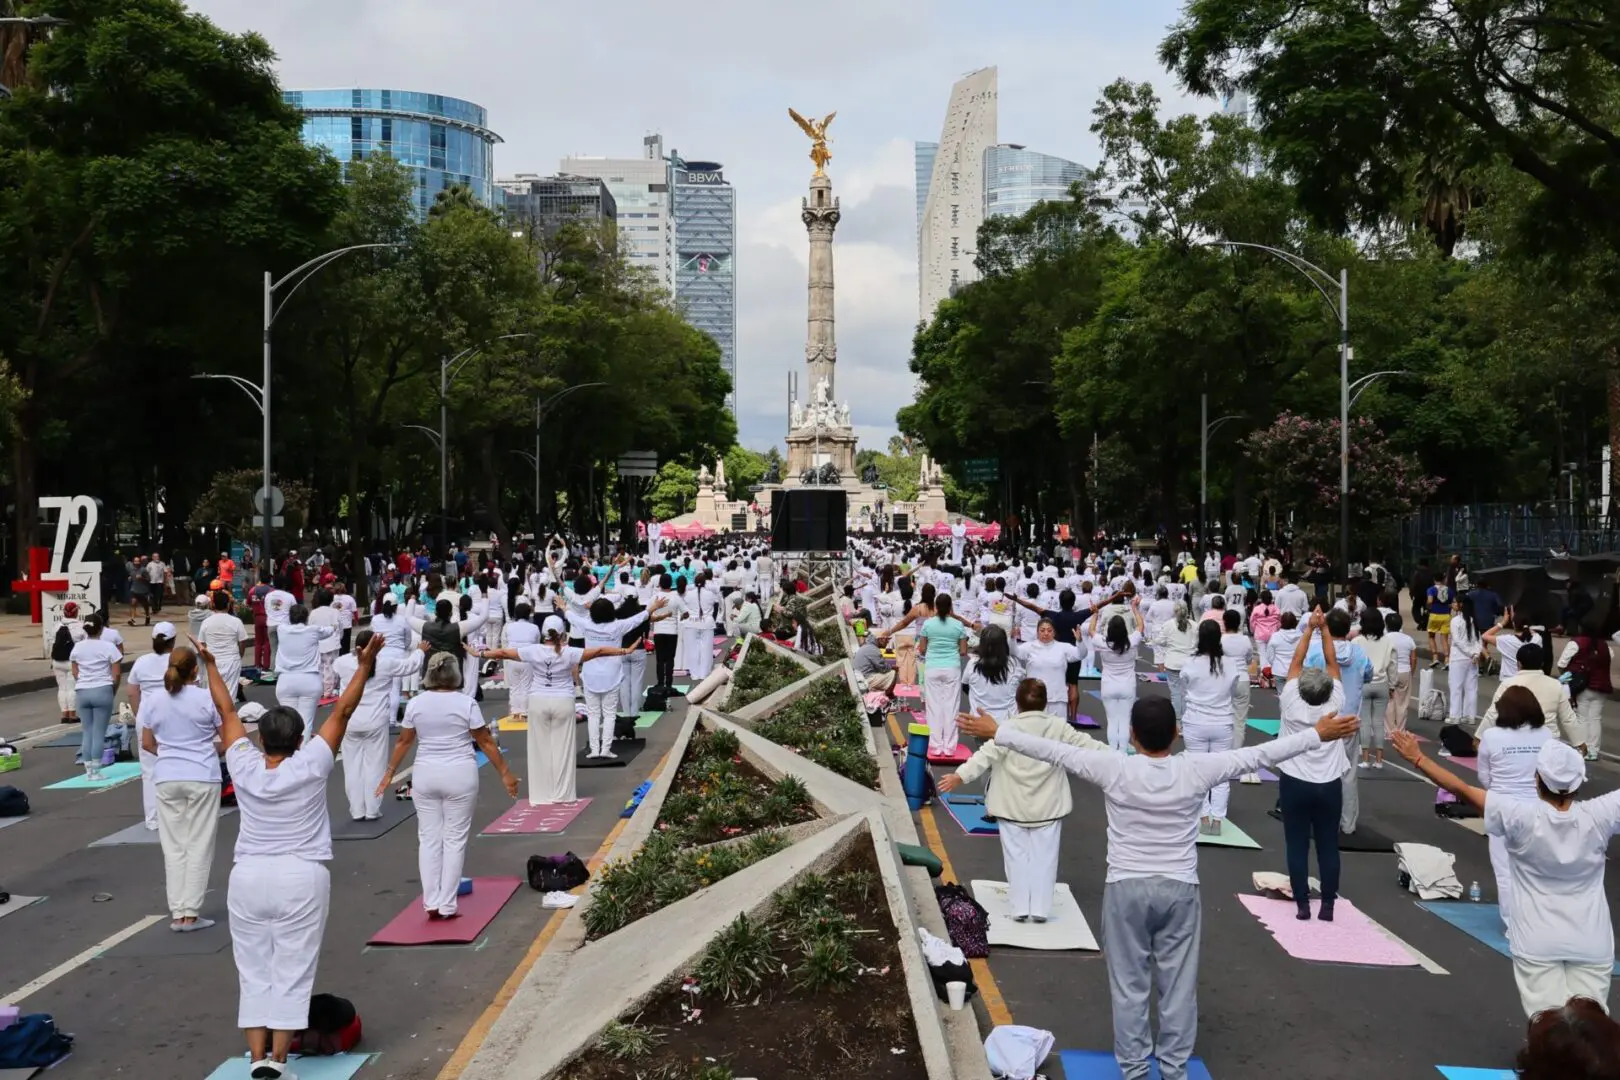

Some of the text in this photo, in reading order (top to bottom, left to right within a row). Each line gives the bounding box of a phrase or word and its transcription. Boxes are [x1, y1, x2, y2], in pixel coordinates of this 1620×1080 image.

[688, 172, 721, 182] BBVA
[39, 495, 102, 573] 72
[1232, 593, 1242, 604] 27
